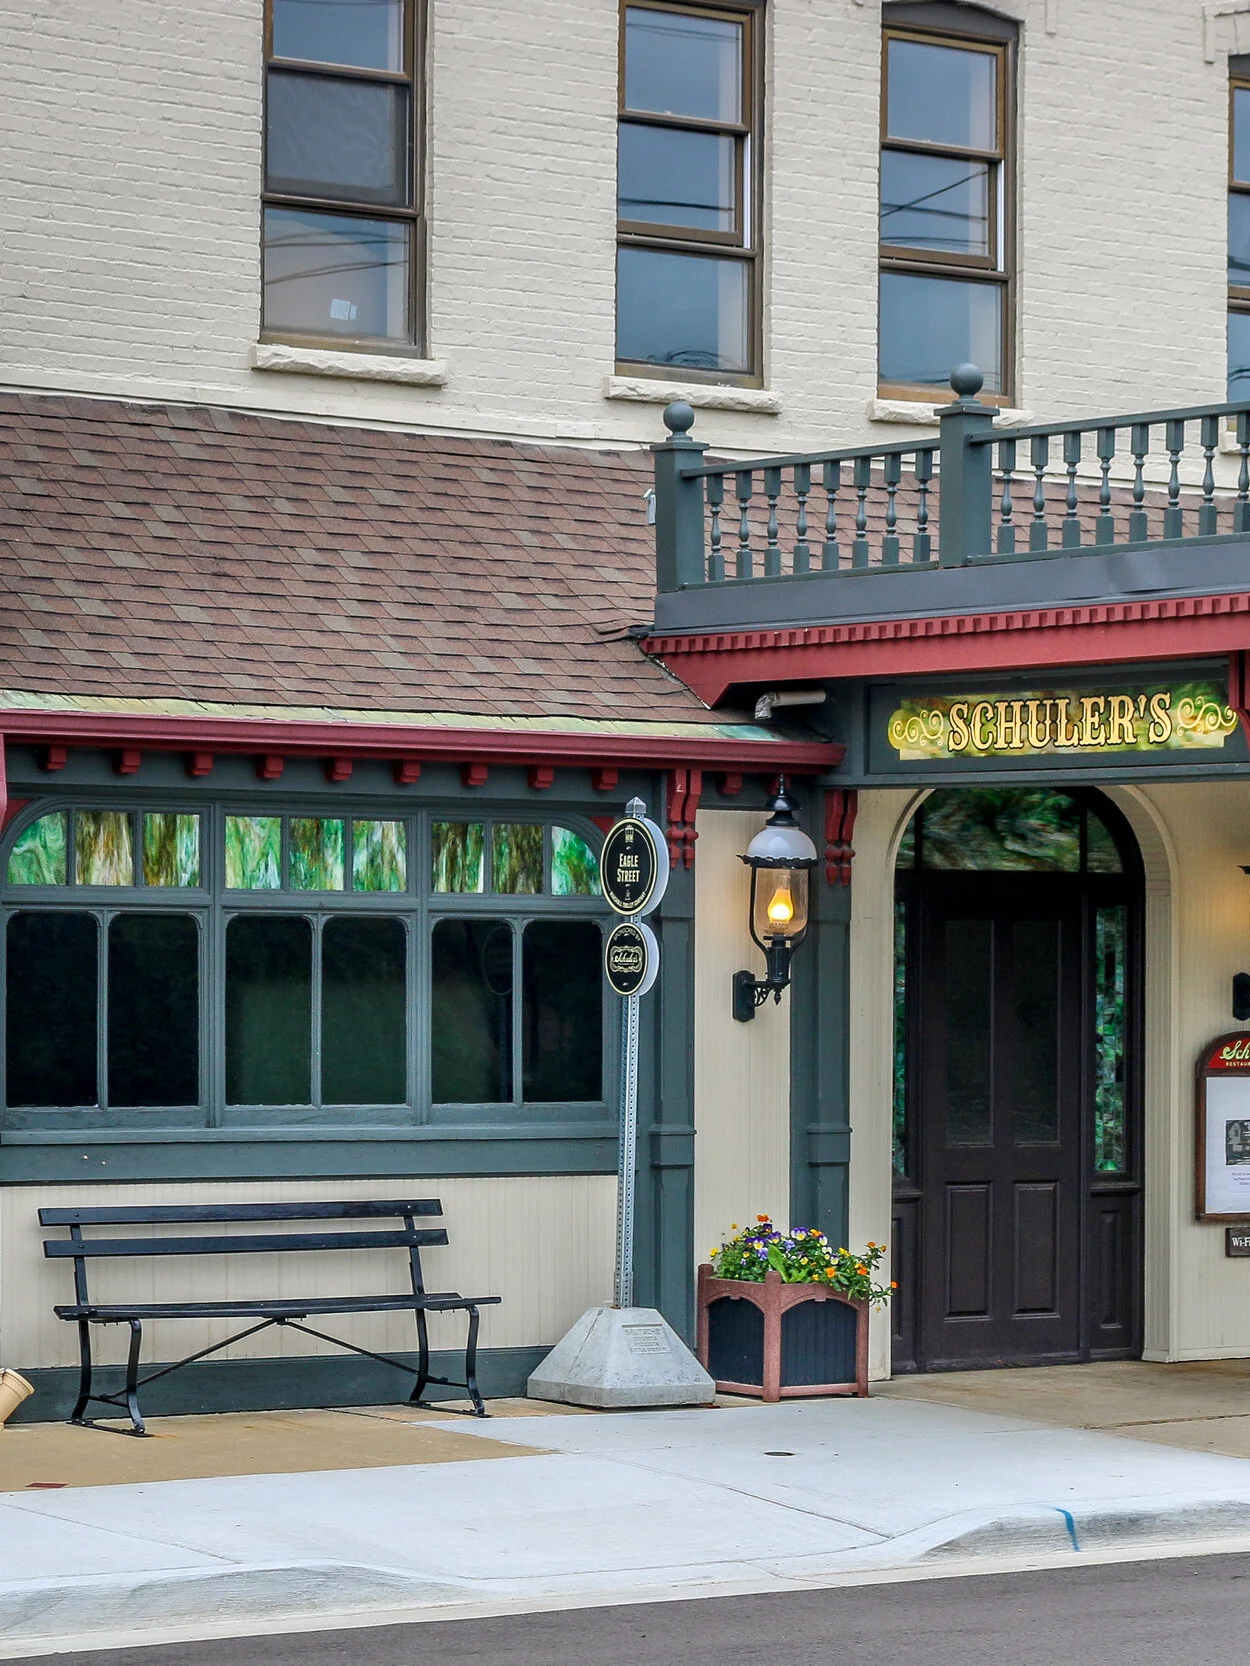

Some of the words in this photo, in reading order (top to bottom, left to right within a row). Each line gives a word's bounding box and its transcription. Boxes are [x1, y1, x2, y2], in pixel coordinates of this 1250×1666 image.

[948, 692, 1172, 752] SCHULER'S
[619, 853, 639, 867] EAGLE
[616, 868, 640, 882] STREET
